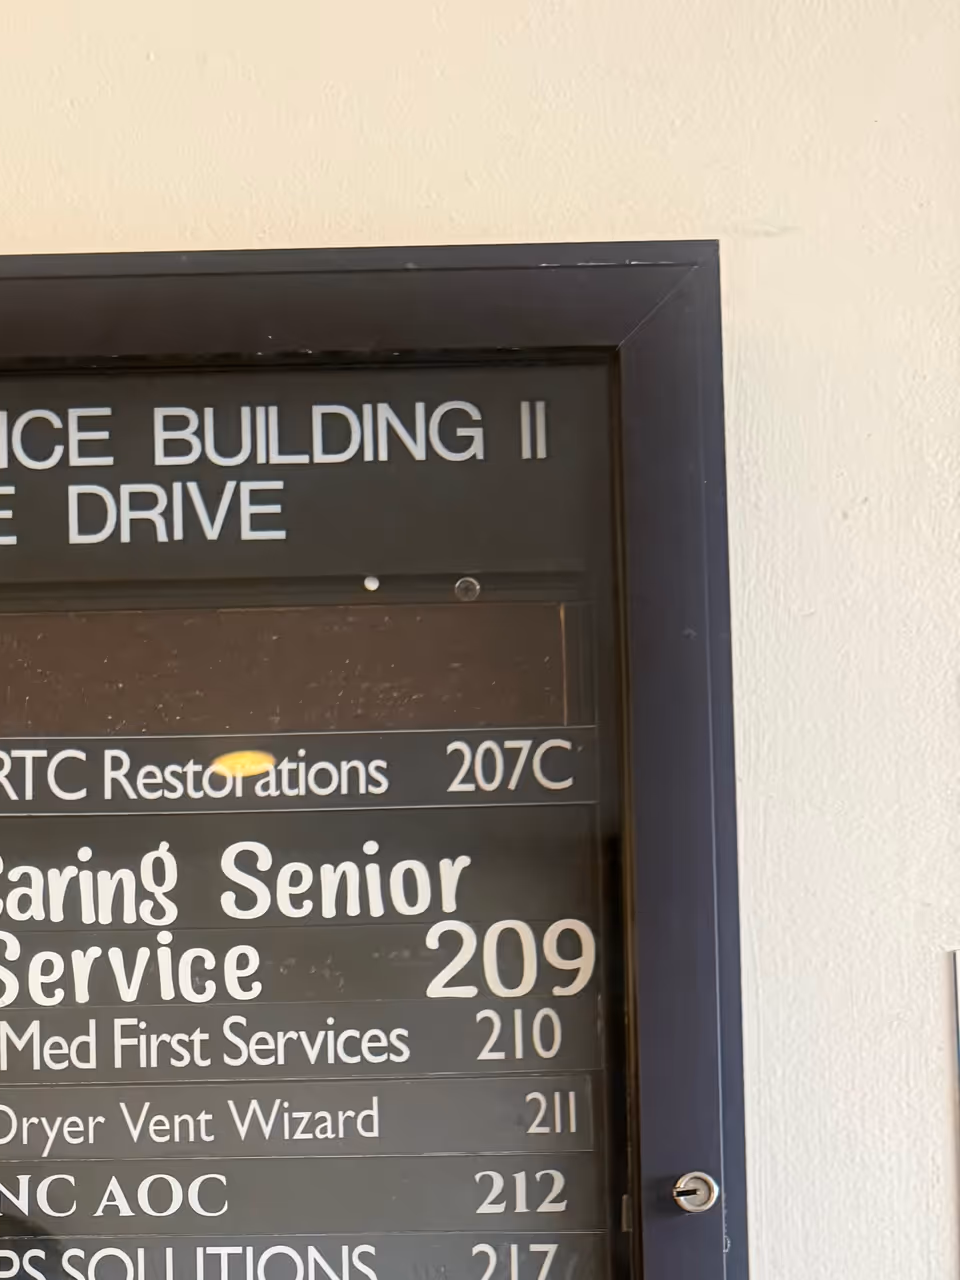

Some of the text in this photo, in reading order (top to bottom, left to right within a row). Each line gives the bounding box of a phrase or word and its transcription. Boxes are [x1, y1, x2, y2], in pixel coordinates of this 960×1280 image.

[153, 401, 484, 467] BUILDING
[521, 401, 547, 459] II
[68, 481, 286, 544] DRIVE
[104, 749, 388, 799] Restorations
[446, 740, 574, 792] 207C
[221, 840, 470, 919] Senior
[425, 919, 596, 999] 209
[0, 1008, 561, 1071] Med First Services 210
[120, 1101, 214, 1143] Vent
[228, 1097, 379, 1141] Wizard
[525, 1092, 576, 1135] 211
[94, 1173, 228, 1217] AOC
[475, 1169, 567, 1214] 212
